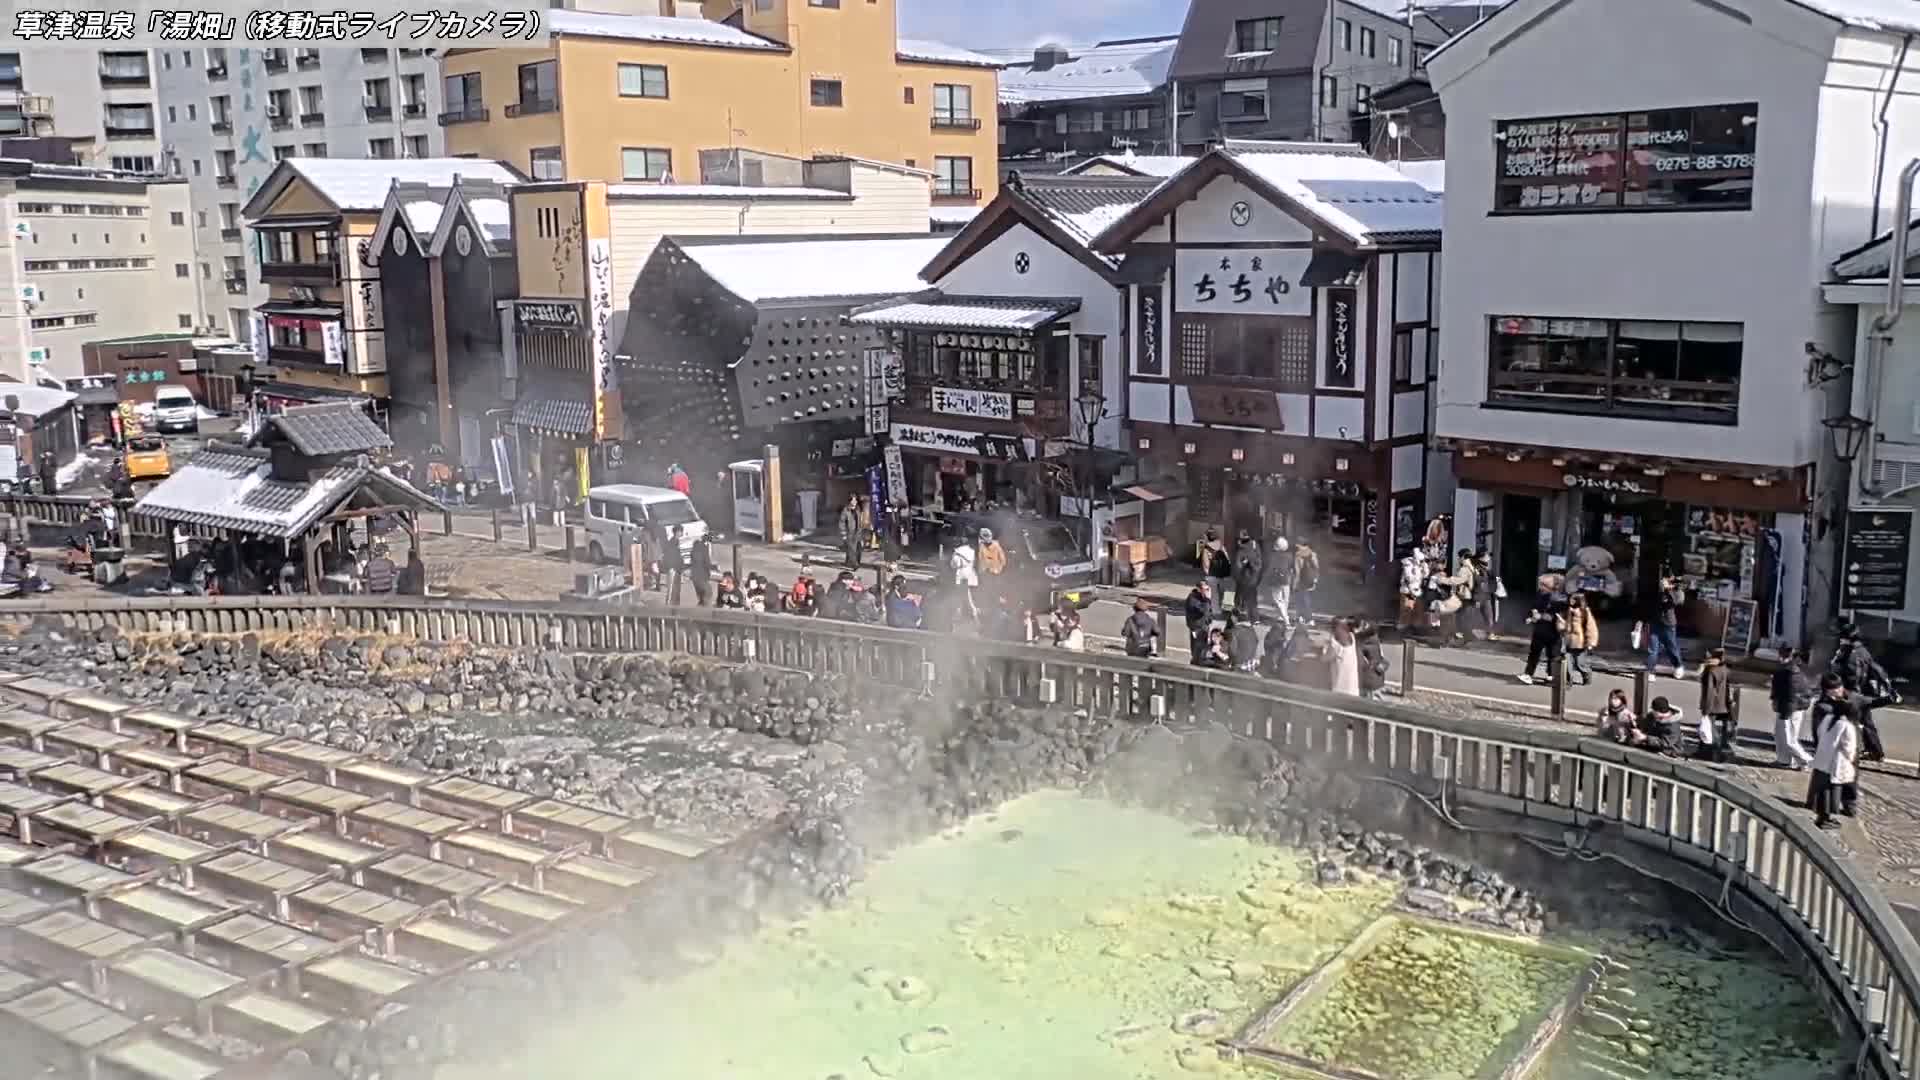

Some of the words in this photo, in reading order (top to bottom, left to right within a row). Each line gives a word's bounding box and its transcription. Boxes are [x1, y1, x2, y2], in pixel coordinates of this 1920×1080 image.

[1519, 183, 1602, 208] カラオケ
[1193, 273, 1291, 304] ちちや
